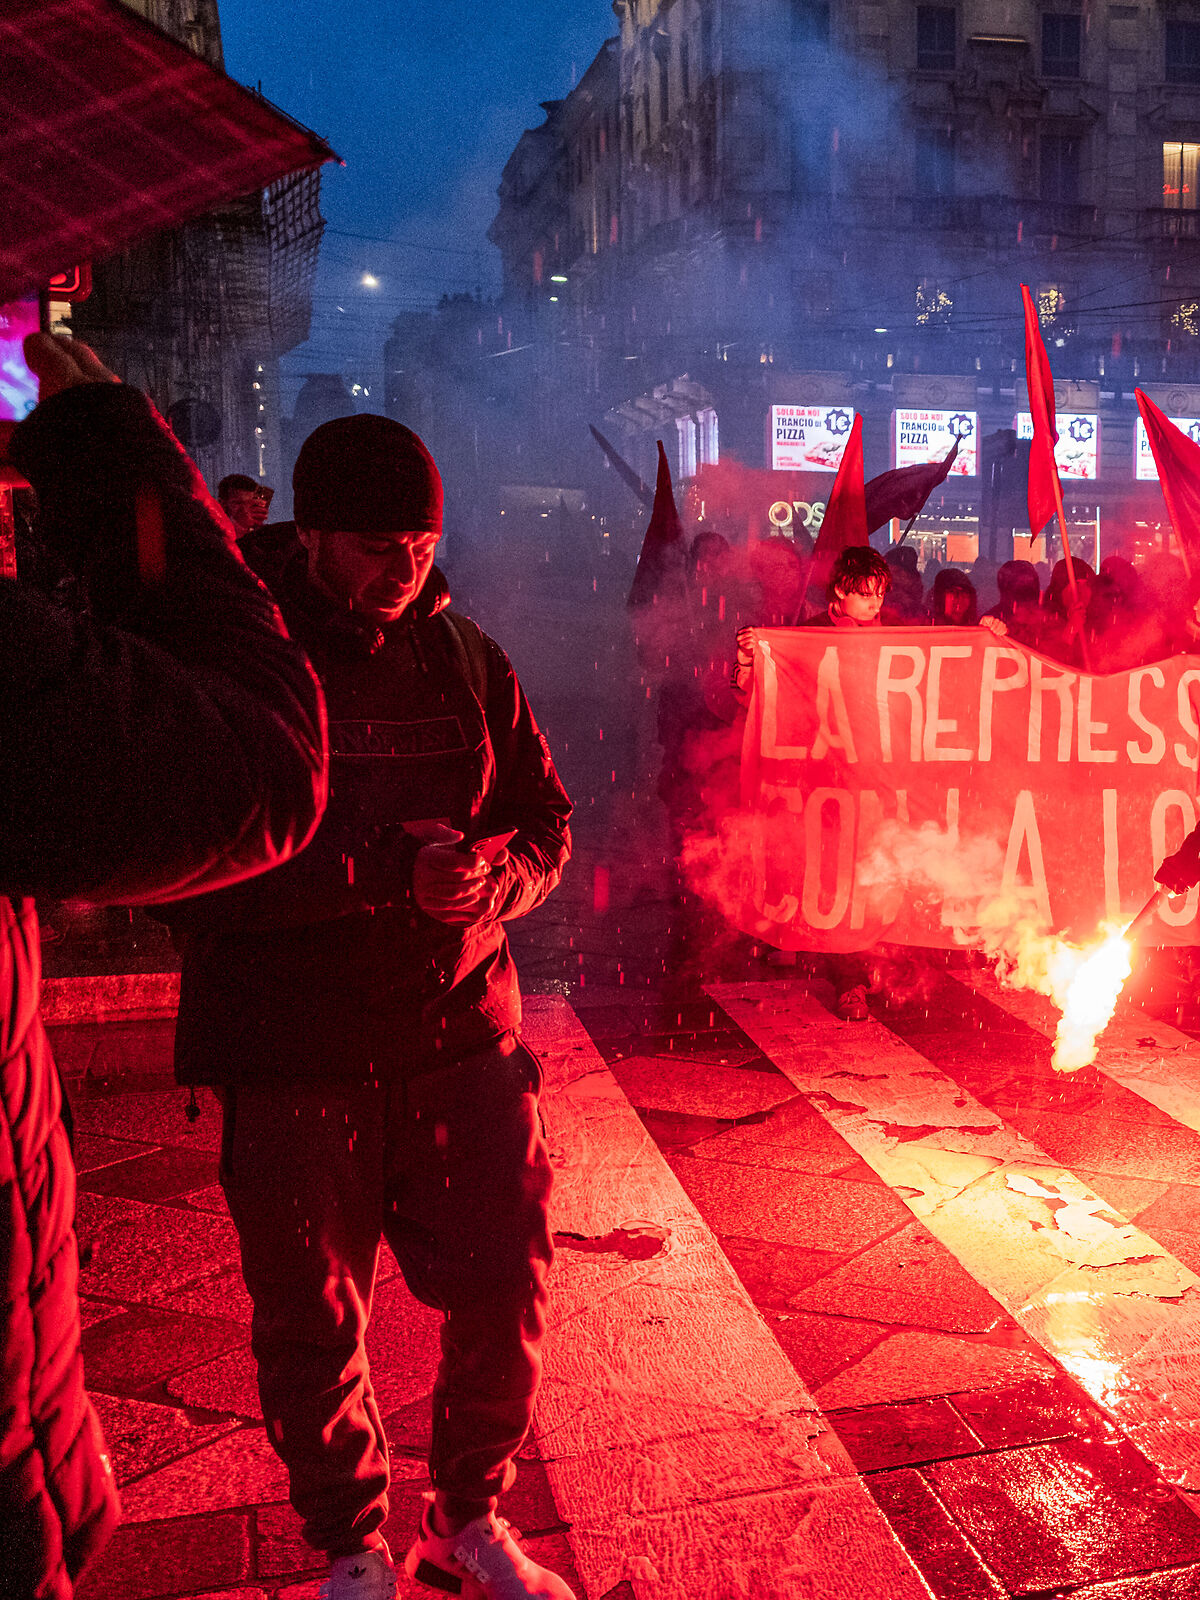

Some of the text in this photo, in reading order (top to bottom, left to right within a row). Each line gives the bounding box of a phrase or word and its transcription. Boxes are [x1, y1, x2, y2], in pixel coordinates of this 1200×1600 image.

[776, 407, 820, 417] SOLO DA NOI
[900, 412, 918, 421] SOLO
[920, 413, 929, 421] DA
[776, 417, 814, 427] TRANCIO
[828, 413, 849, 431] 1€
[900, 422, 937, 432] TRANCIO
[951, 417, 972, 435] 1€
[776, 428, 806, 440] PIZZA
[1071, 420, 1092, 438] 1€
[900, 433, 929, 444] PIZZA
[758, 639, 859, 763] LA
[753, 783, 910, 930] CON
[941, 788, 1054, 927] LA
